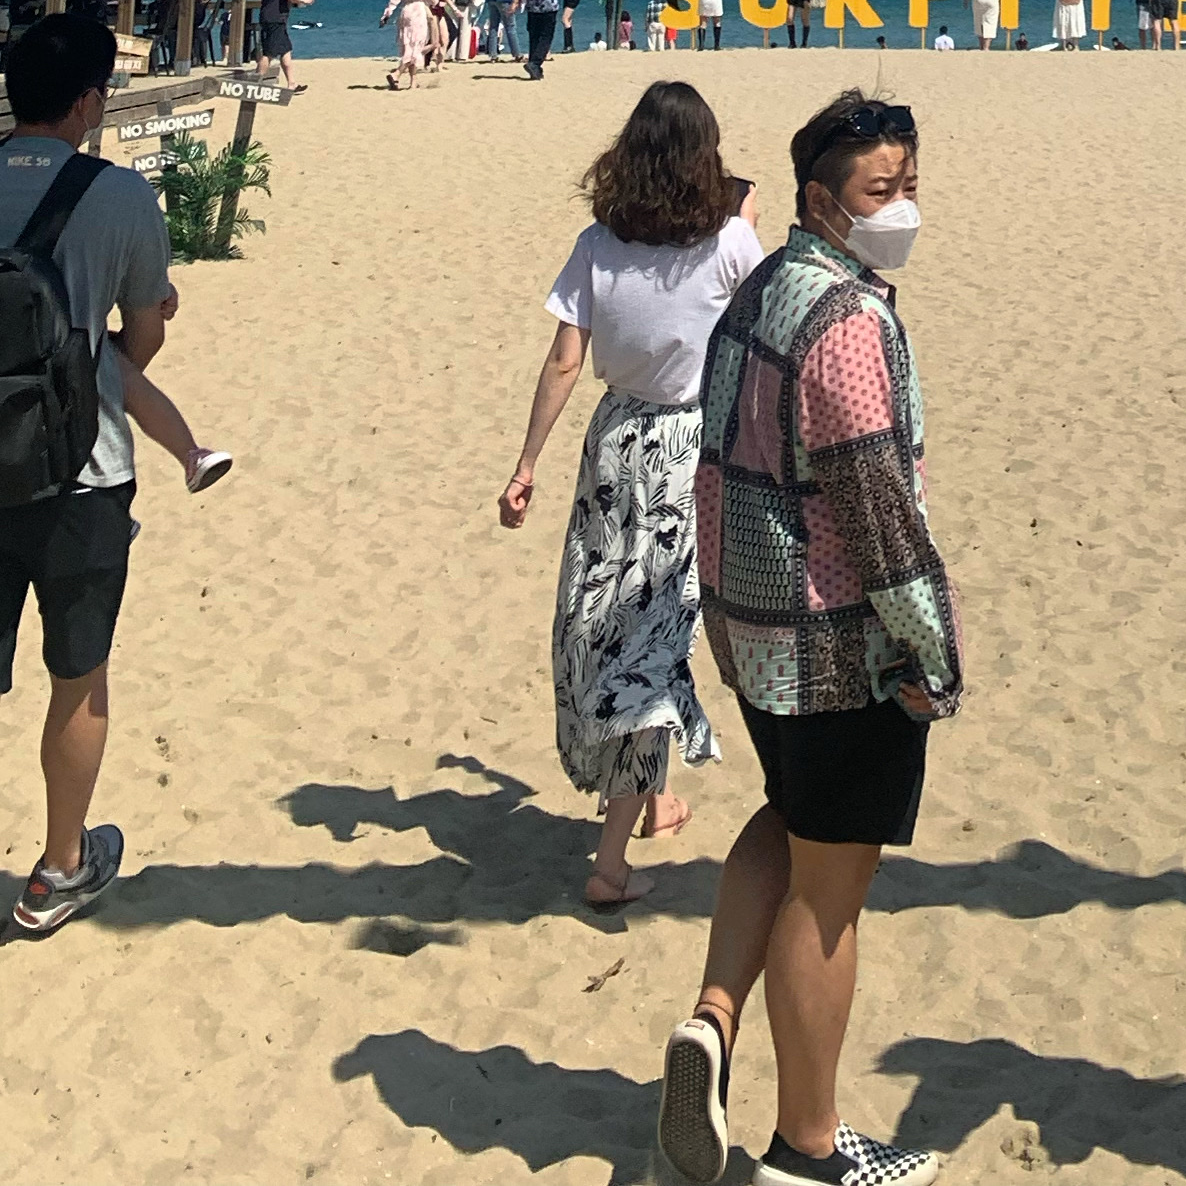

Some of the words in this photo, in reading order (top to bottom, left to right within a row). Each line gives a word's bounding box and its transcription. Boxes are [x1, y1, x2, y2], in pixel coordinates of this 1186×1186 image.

[219, 81, 244, 97] NO
[246, 85, 281, 102] TUBE
[120, 125, 143, 140] NO
[144, 112, 211, 135] SMOKING
[134, 156, 157, 172] NO
